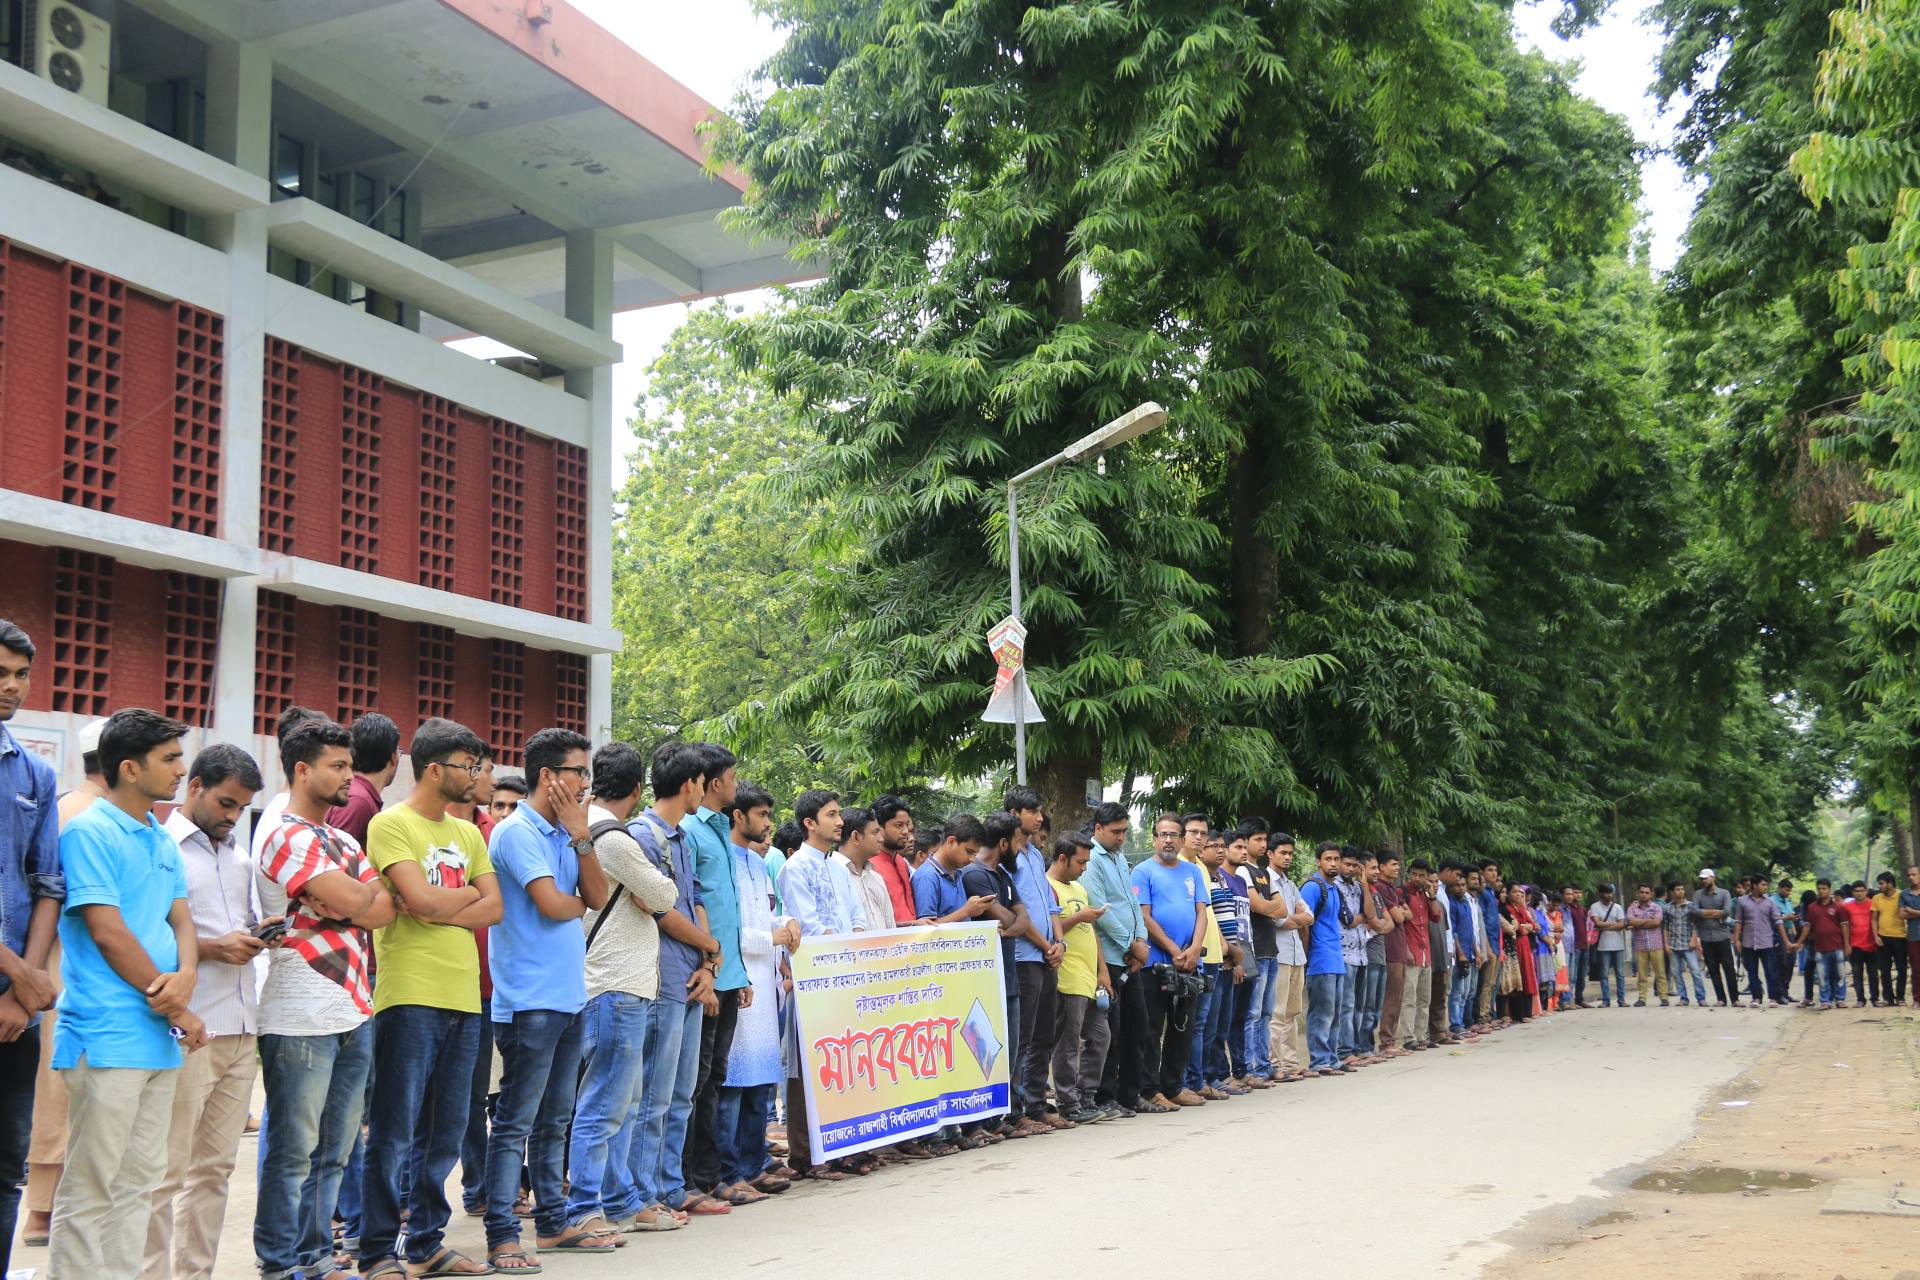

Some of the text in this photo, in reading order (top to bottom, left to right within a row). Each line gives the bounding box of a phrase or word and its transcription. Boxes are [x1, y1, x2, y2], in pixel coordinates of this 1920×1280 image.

[797, 977, 830, 992] আরাফাত
[867, 971, 882, 983] উপর
[813, 1016, 960, 1092] মানববন্ধন
[858, 1113, 888, 1136] রাজশাহী
